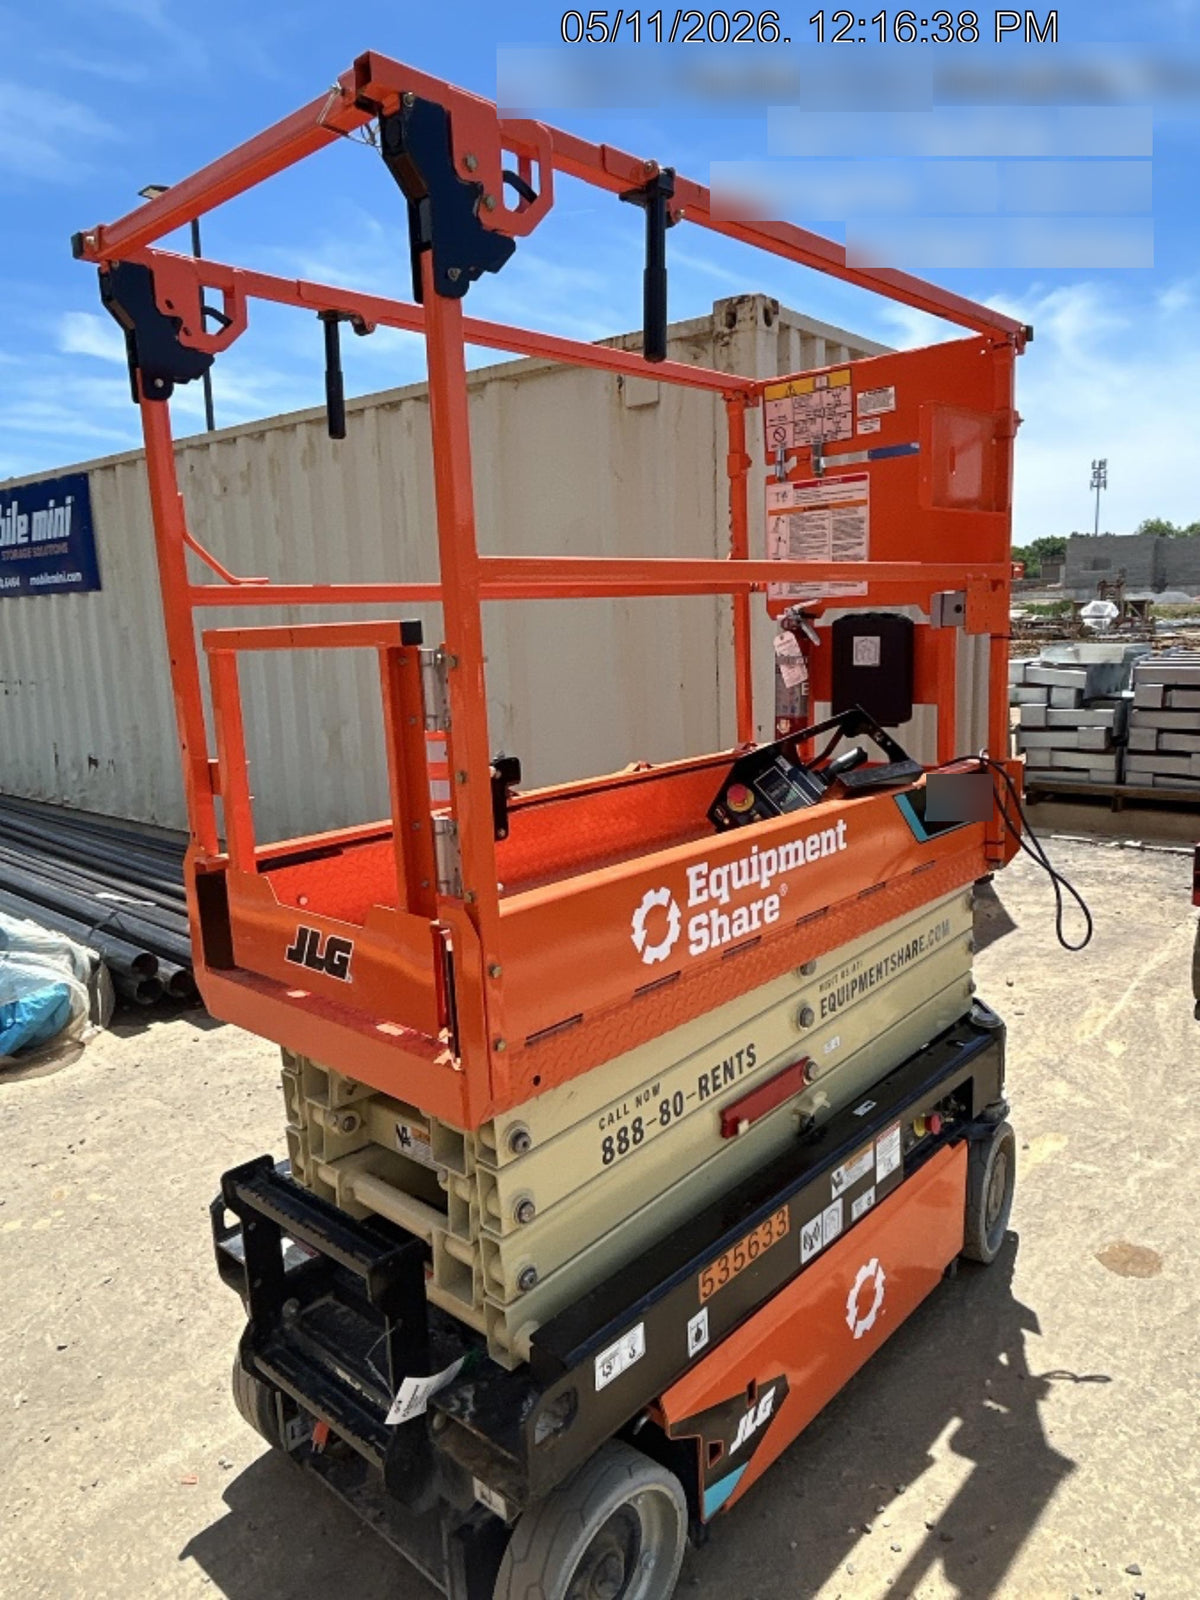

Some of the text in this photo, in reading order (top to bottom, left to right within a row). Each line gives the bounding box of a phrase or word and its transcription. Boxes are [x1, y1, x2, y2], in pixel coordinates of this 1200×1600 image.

[32, 496, 71, 541] mini
[686, 818, 848, 909] Equipment
[284, 924, 354, 983] JLG
[820, 917, 950, 1019] EQUIPMENTSHARE.COM
[598, 1082, 661, 1131] CALL NOW
[601, 1042, 757, 1166] 888-80-RENTS
[702, 1209, 788, 1299] 535633
[728, 1385, 777, 1457] JLG
